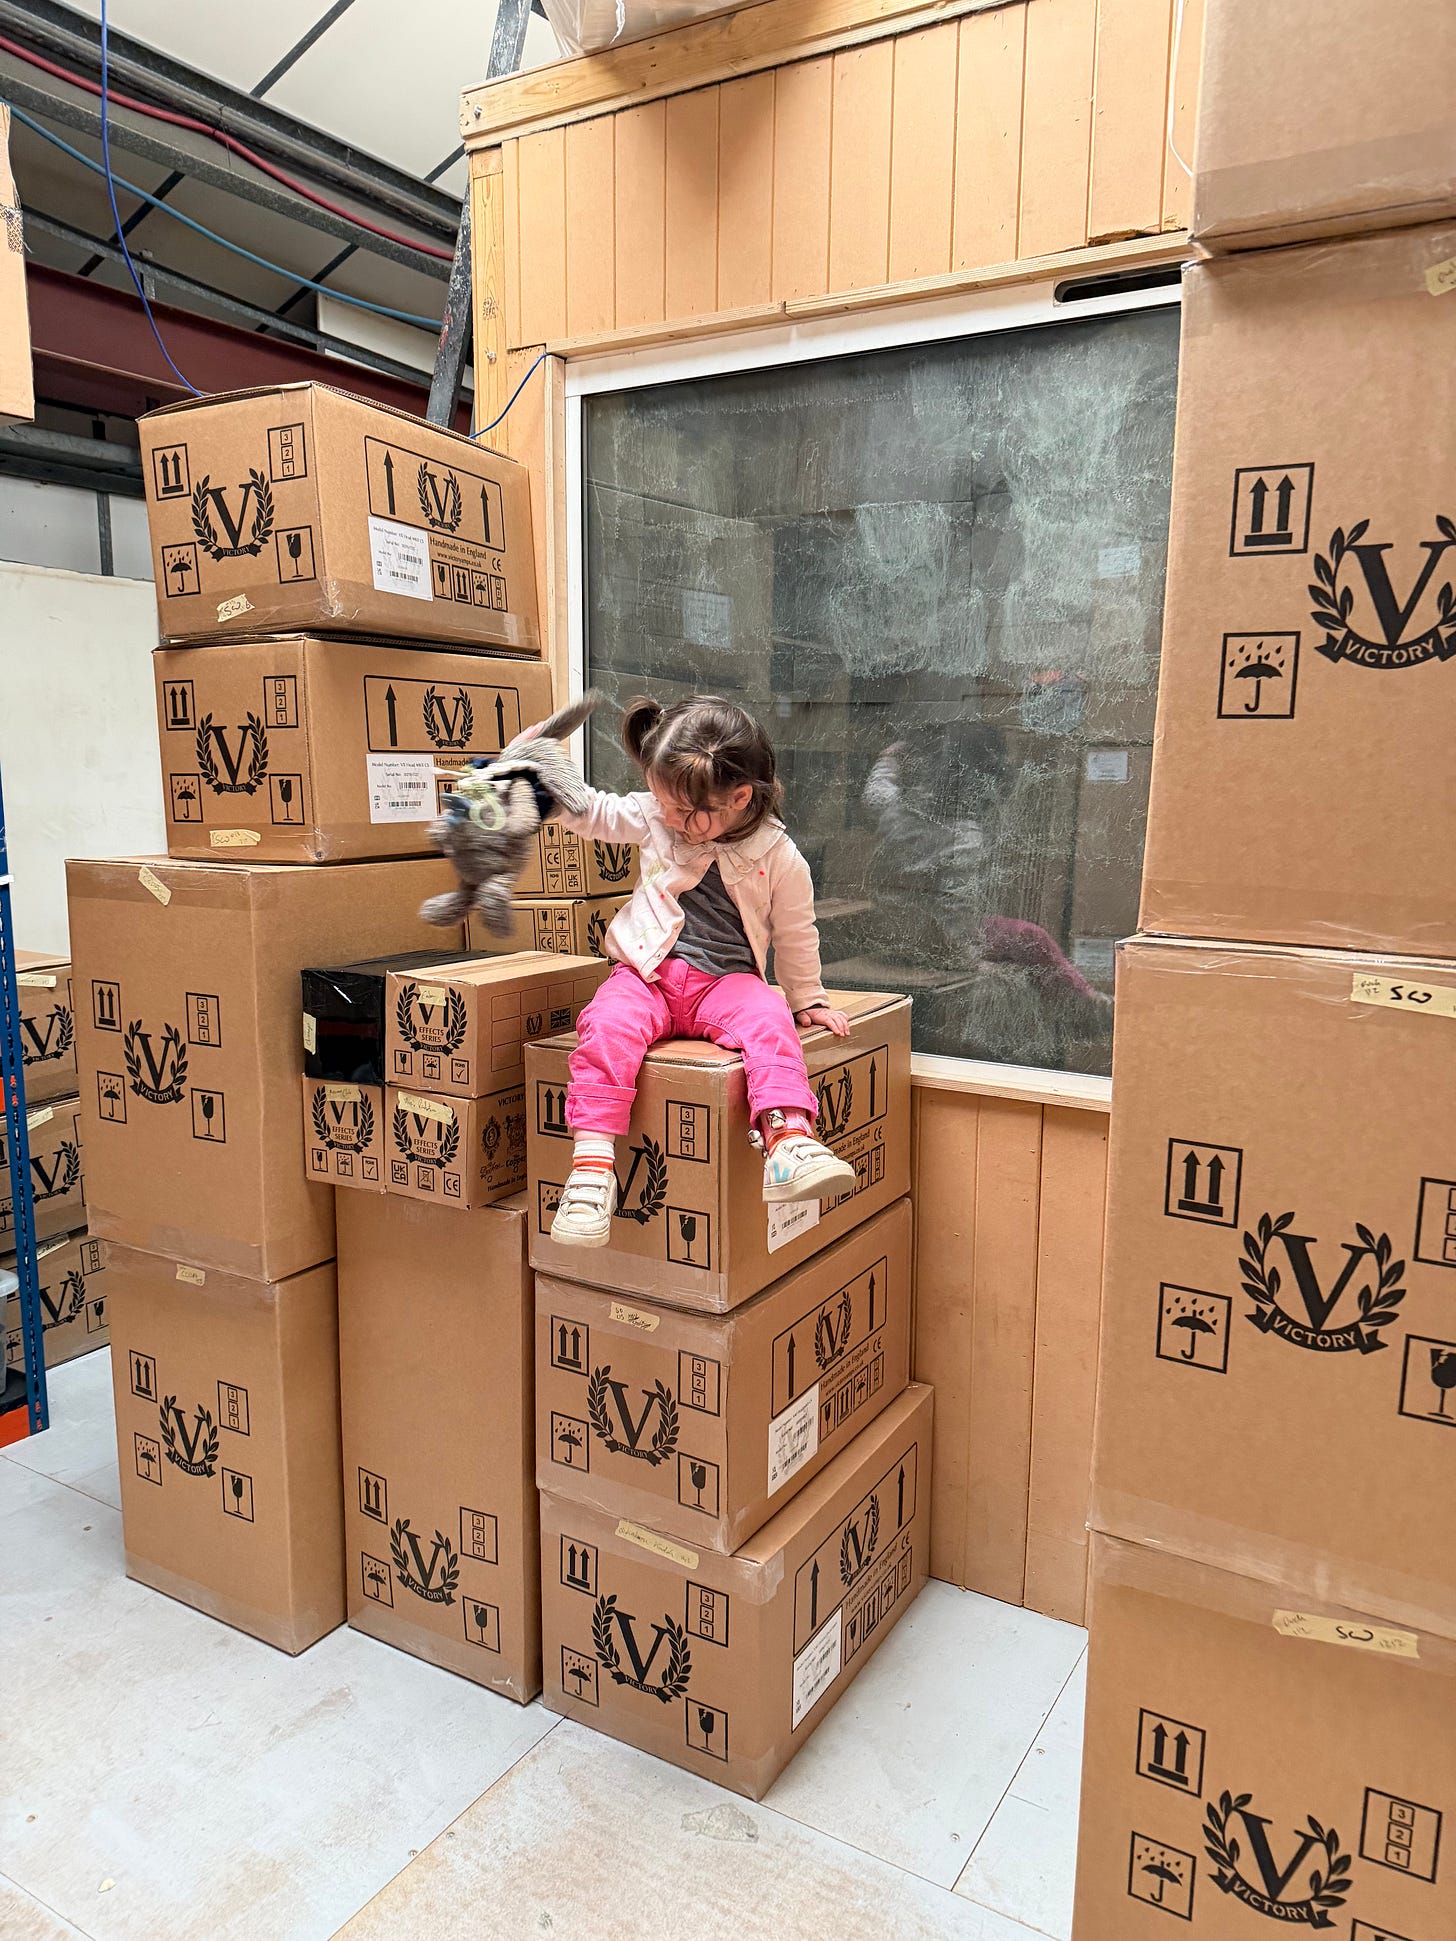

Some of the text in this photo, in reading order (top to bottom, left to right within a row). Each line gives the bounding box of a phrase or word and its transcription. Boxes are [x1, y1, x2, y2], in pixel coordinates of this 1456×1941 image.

[426, 473, 451, 522] V
[207, 482, 253, 548] V
[222, 546, 250, 557] VICTORY
[430, 537, 459, 552] Handmade
[460, 545, 465, 553] in
[467, 547, 486, 560] England
[1346, 541, 1455, 645] V
[1345, 638, 1434, 664] VICTORY
[433, 696, 462, 741] V
[210, 726, 251, 785] V
[222, 783, 247, 792] VICTORY
[20, 1013, 59, 1056] V
[419, 1027, 444, 1036] EFFECTS
[421, 1034, 442, 1043] SERIES
[134, 1033, 174, 1090] V
[140, 1084, 173, 1101] VICTORY
[823, 1080, 844, 1130] V
[685, 1111, 690, 1119] 3
[332, 1126, 355, 1135] EFFECTS
[334, 1133, 353, 1142] SERIES
[685, 1128, 691, 1136] 2
[414, 1139, 438, 1149] EFFECTS
[416, 1147, 436, 1156] SERIES
[1274, 1232, 1376, 1330] V
[823, 1303, 843, 1356] V
[1273, 1315, 1357, 1348] VICTORY
[697, 1363, 702, 1371] 3
[696, 1379, 702, 1388] 2
[697, 1395, 701, 1403] 1
[607, 1379, 660, 1449] V
[170, 1406, 206, 1463] V
[617, 1443, 649, 1459] VICTORY
[175, 1453, 206, 1473] VICTORY
[403, 1530, 443, 1590] V
[409, 1578, 443, 1599] VICTORY
[705, 1595, 710, 1603] 3
[704, 1610, 710, 1618] 2
[705, 1626, 709, 1634] 1
[614, 1609, 668, 1683] V
[625, 1675, 658, 1694] VICTORY
[1398, 1809, 1406, 1819] 3
[1395, 1830, 1405, 1840] 2
[1235, 1808, 1322, 1901] V
[1393, 1851, 1401, 1861] 1
[1233, 1883, 1309, 1920] VICTORY
